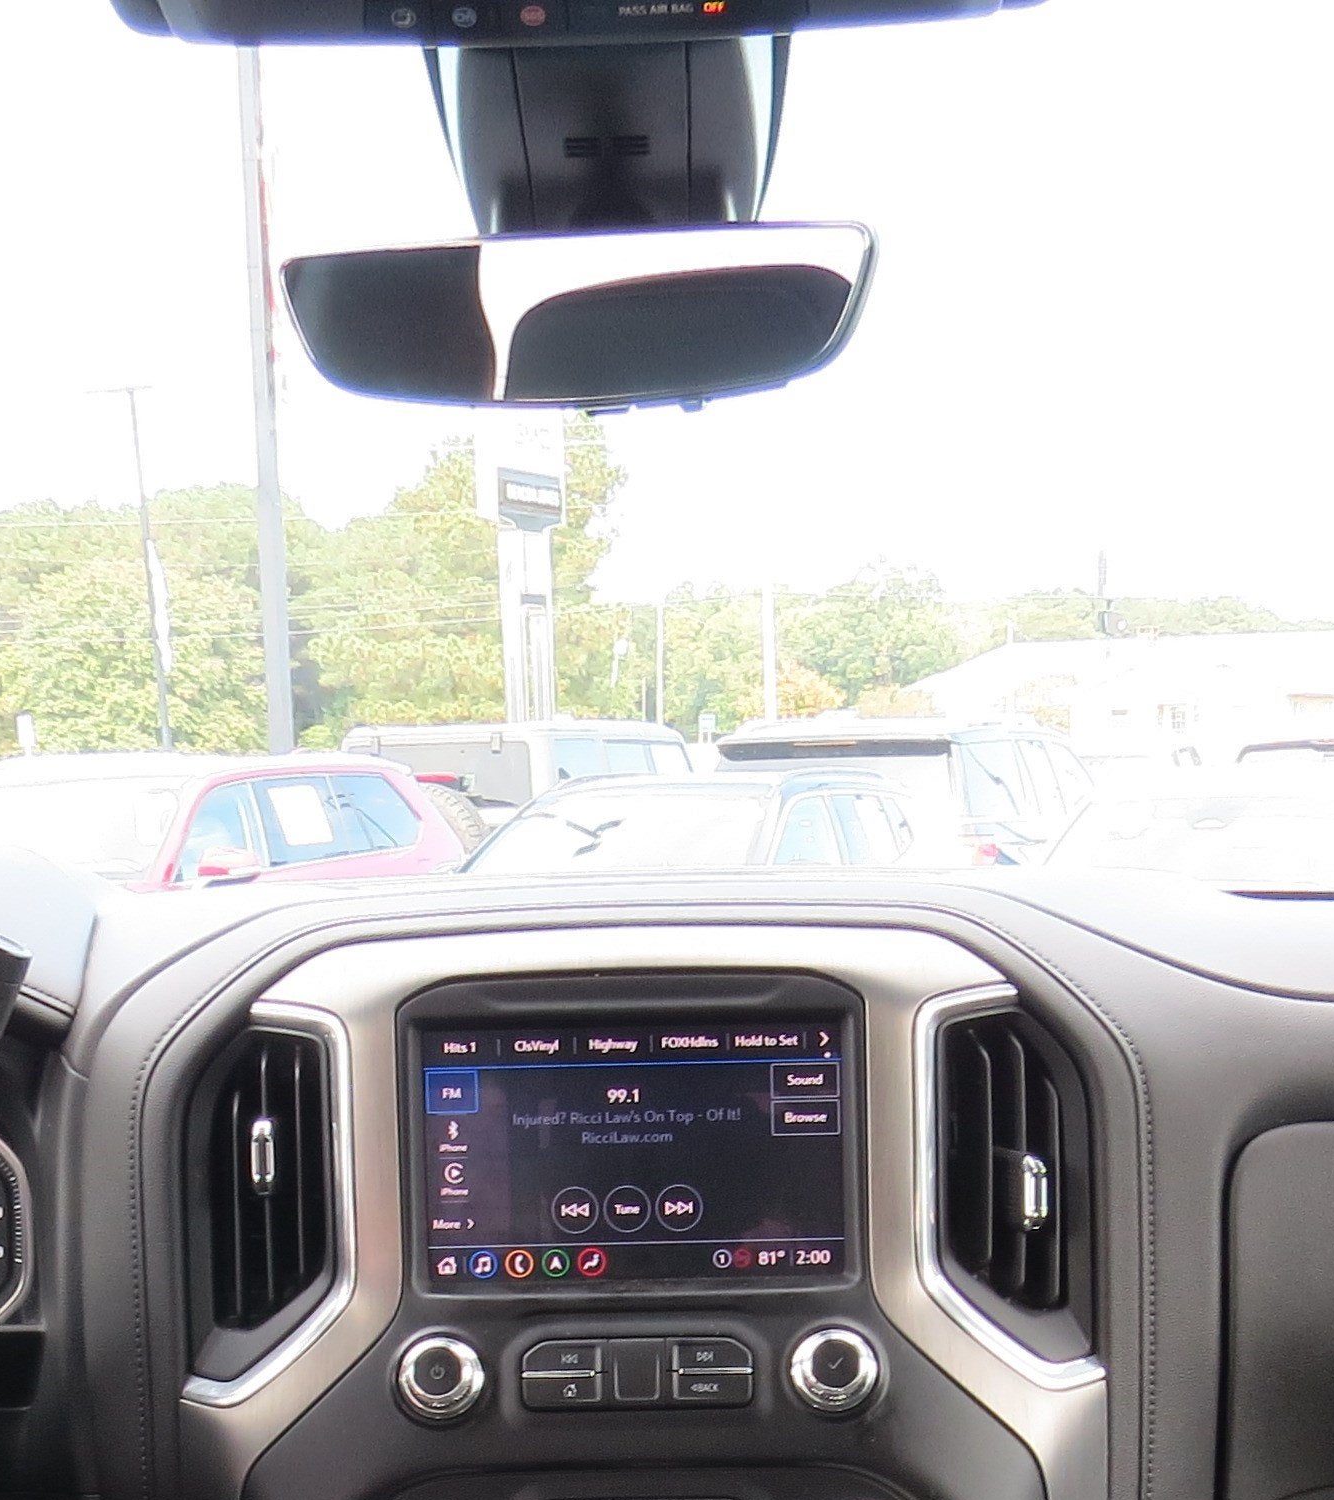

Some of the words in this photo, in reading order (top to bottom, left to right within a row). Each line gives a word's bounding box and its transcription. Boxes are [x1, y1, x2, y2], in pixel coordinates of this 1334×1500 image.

[618, 6, 647, 16] PASS
[650, 4, 667, 15] AIR
[671, 3, 694, 14] BAG
[703, 1, 726, 13] OFF
[588, 1038, 638, 1053] Highway
[734, 1035, 763, 1047] Hold
[764, 1036, 777, 1047] to
[779, 1034, 799, 1046] Set
[443, 1042, 468, 1054] Hits
[470, 1041, 477, 1053] 1
[787, 1074, 824, 1087] Sound
[442, 1087, 462, 1099] FM
[607, 1088, 640, 1104] 99.1
[512, 1112, 566, 1129] Injured?
[570, 1112, 602, 1125] Ricci
[605, 1110, 641, 1124] Law's
[644, 1110, 665, 1123] On
[669, 1109, 694, 1125] Top
[706, 1108, 724, 1122] Of
[727, 1107, 742, 1121] It!
[784, 1111, 828, 1124] Browse
[582, 1131, 673, 1145] RicciLaw.com
[439, 1144, 468, 1153] iPhone
[440, 1187, 469, 1197] iPhone
[614, 1203, 641, 1215] Tune
[432, 1219, 462, 1230] More
[757, 1250, 786, 1266] 81°
[795, 1249, 831, 1265] 2:00
[695, 1383, 720, 1393] BACK
